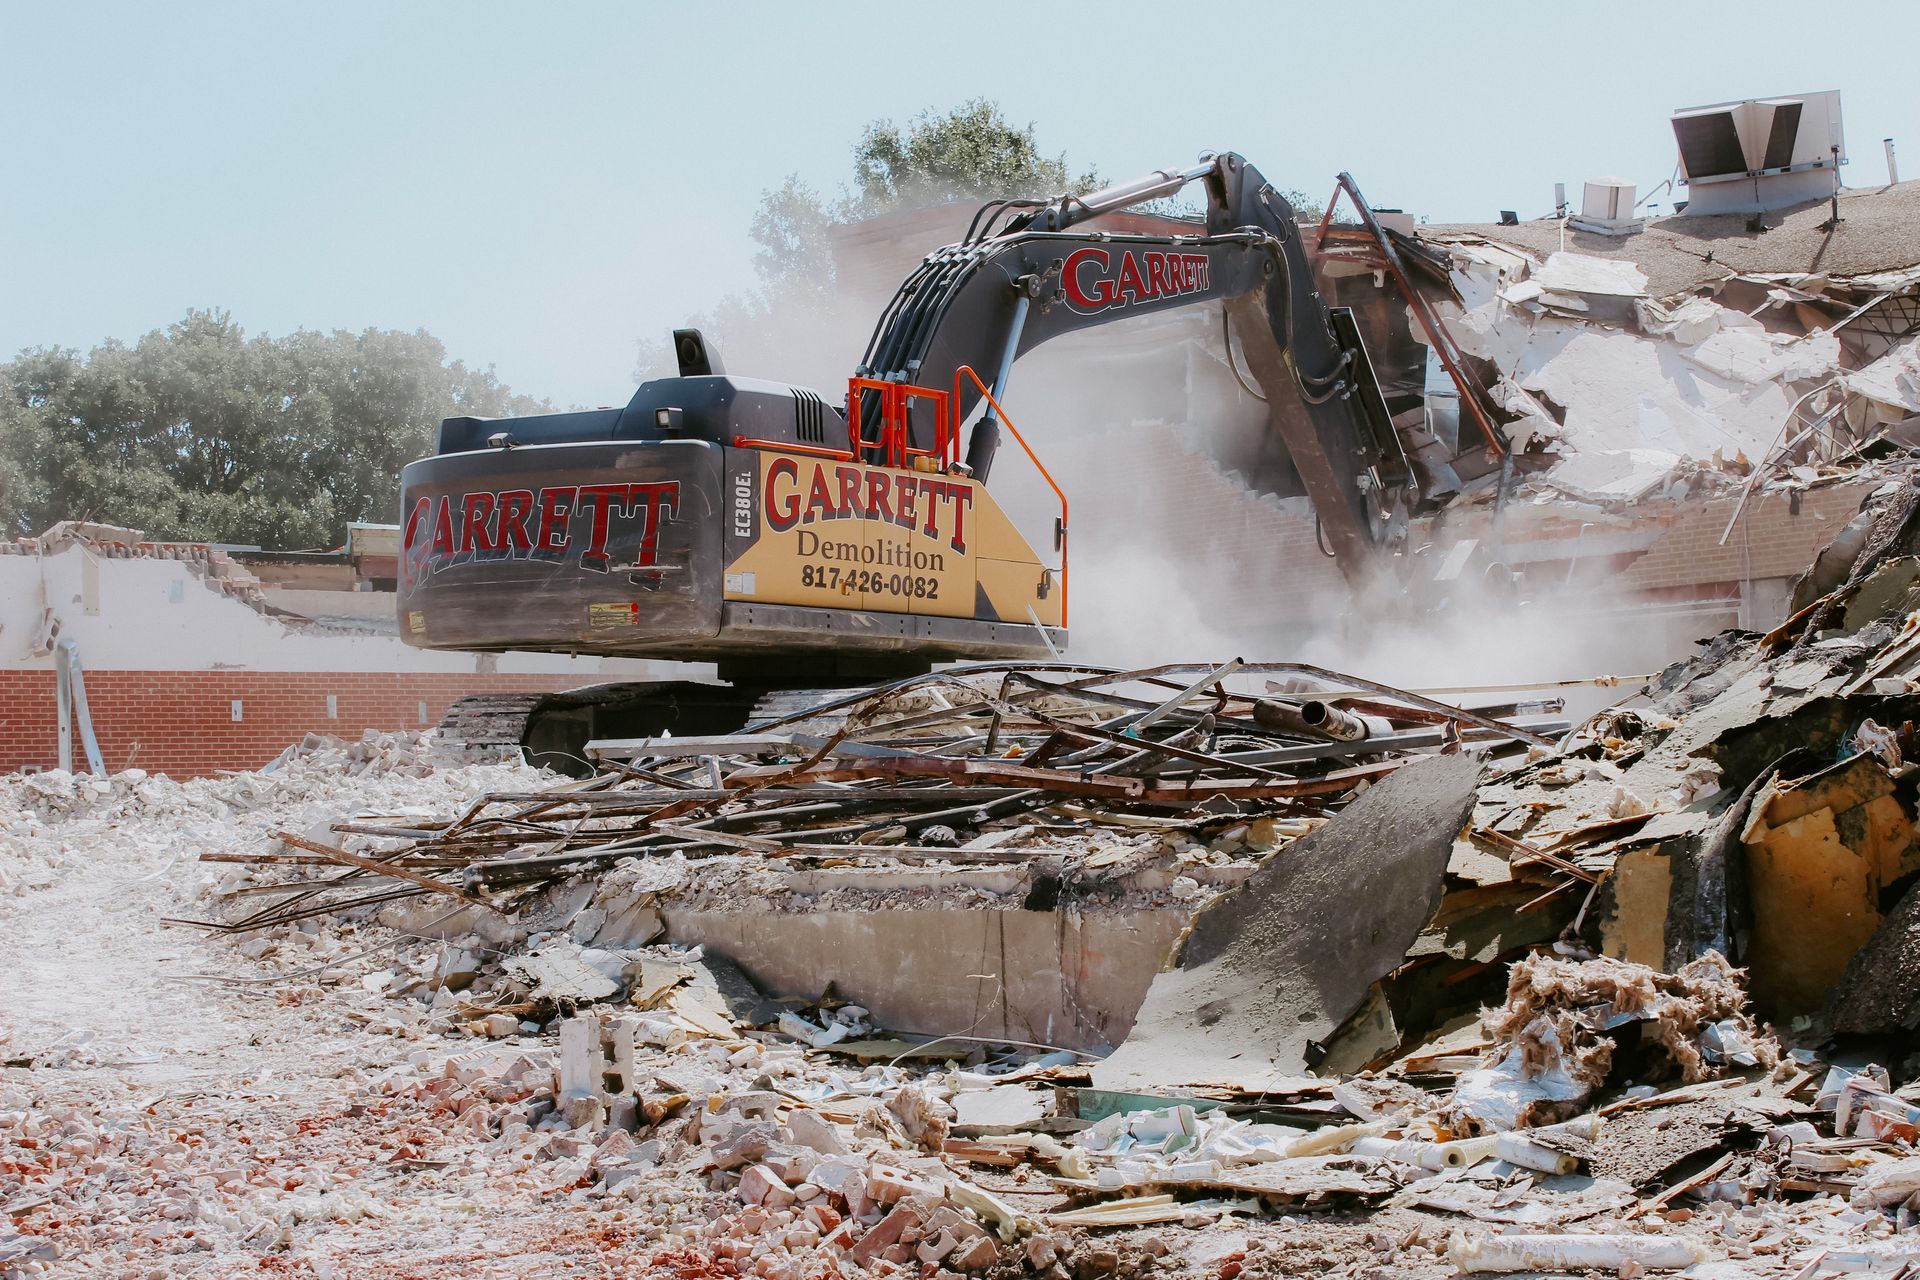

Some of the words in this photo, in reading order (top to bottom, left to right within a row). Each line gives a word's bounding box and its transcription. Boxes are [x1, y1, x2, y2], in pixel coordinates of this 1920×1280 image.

[1060, 248, 1209, 315] GARRETT
[735, 471, 751, 537] EC380EL
[763, 456, 973, 557] GARRETT
[796, 530, 945, 571] Demolition
